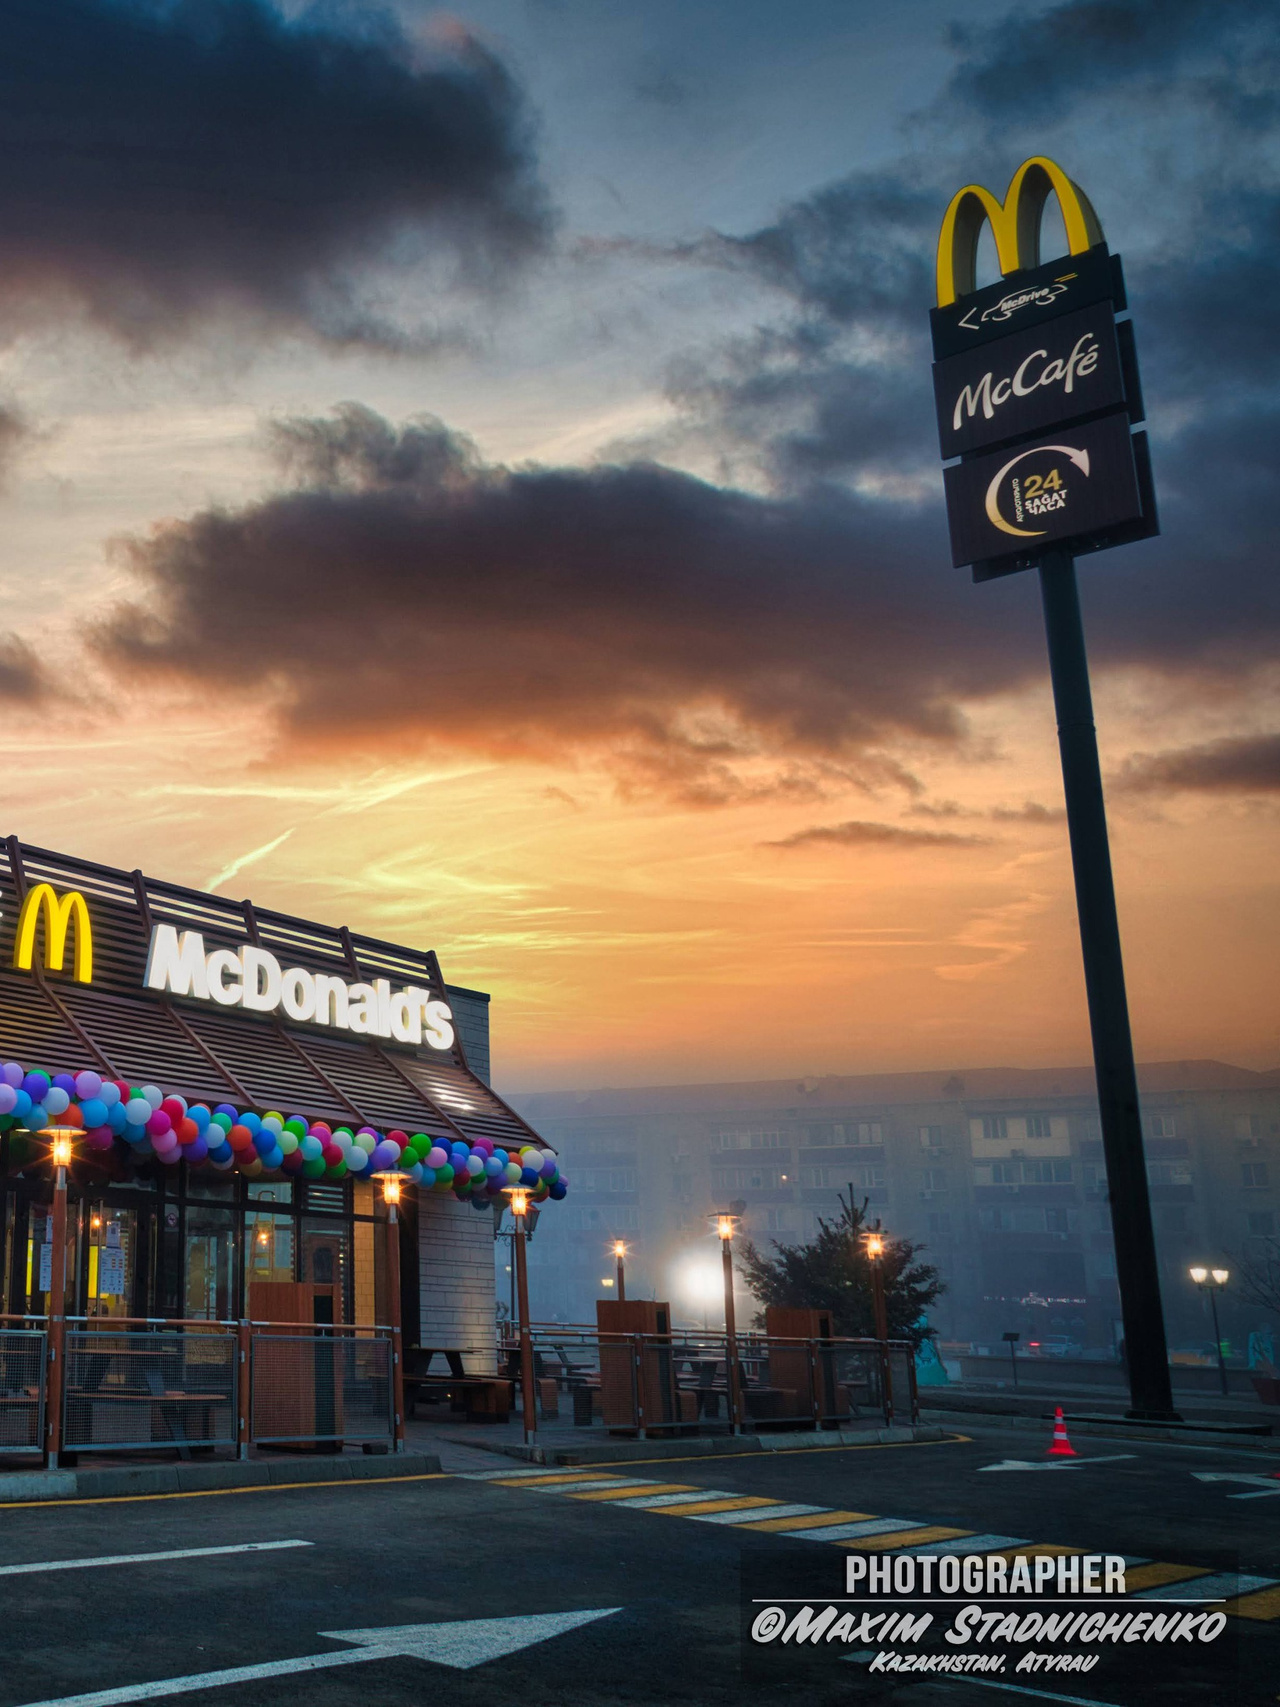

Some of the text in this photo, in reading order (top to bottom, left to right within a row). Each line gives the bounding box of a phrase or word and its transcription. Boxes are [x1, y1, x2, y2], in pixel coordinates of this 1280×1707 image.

[1001, 288, 1049, 311] McDrive
[953, 333, 1099, 430] McCafé
[1024, 469, 1063, 499] 24
[1029, 500, 1066, 515] ЧАСА
[143, 924, 455, 1050] McDonald's
